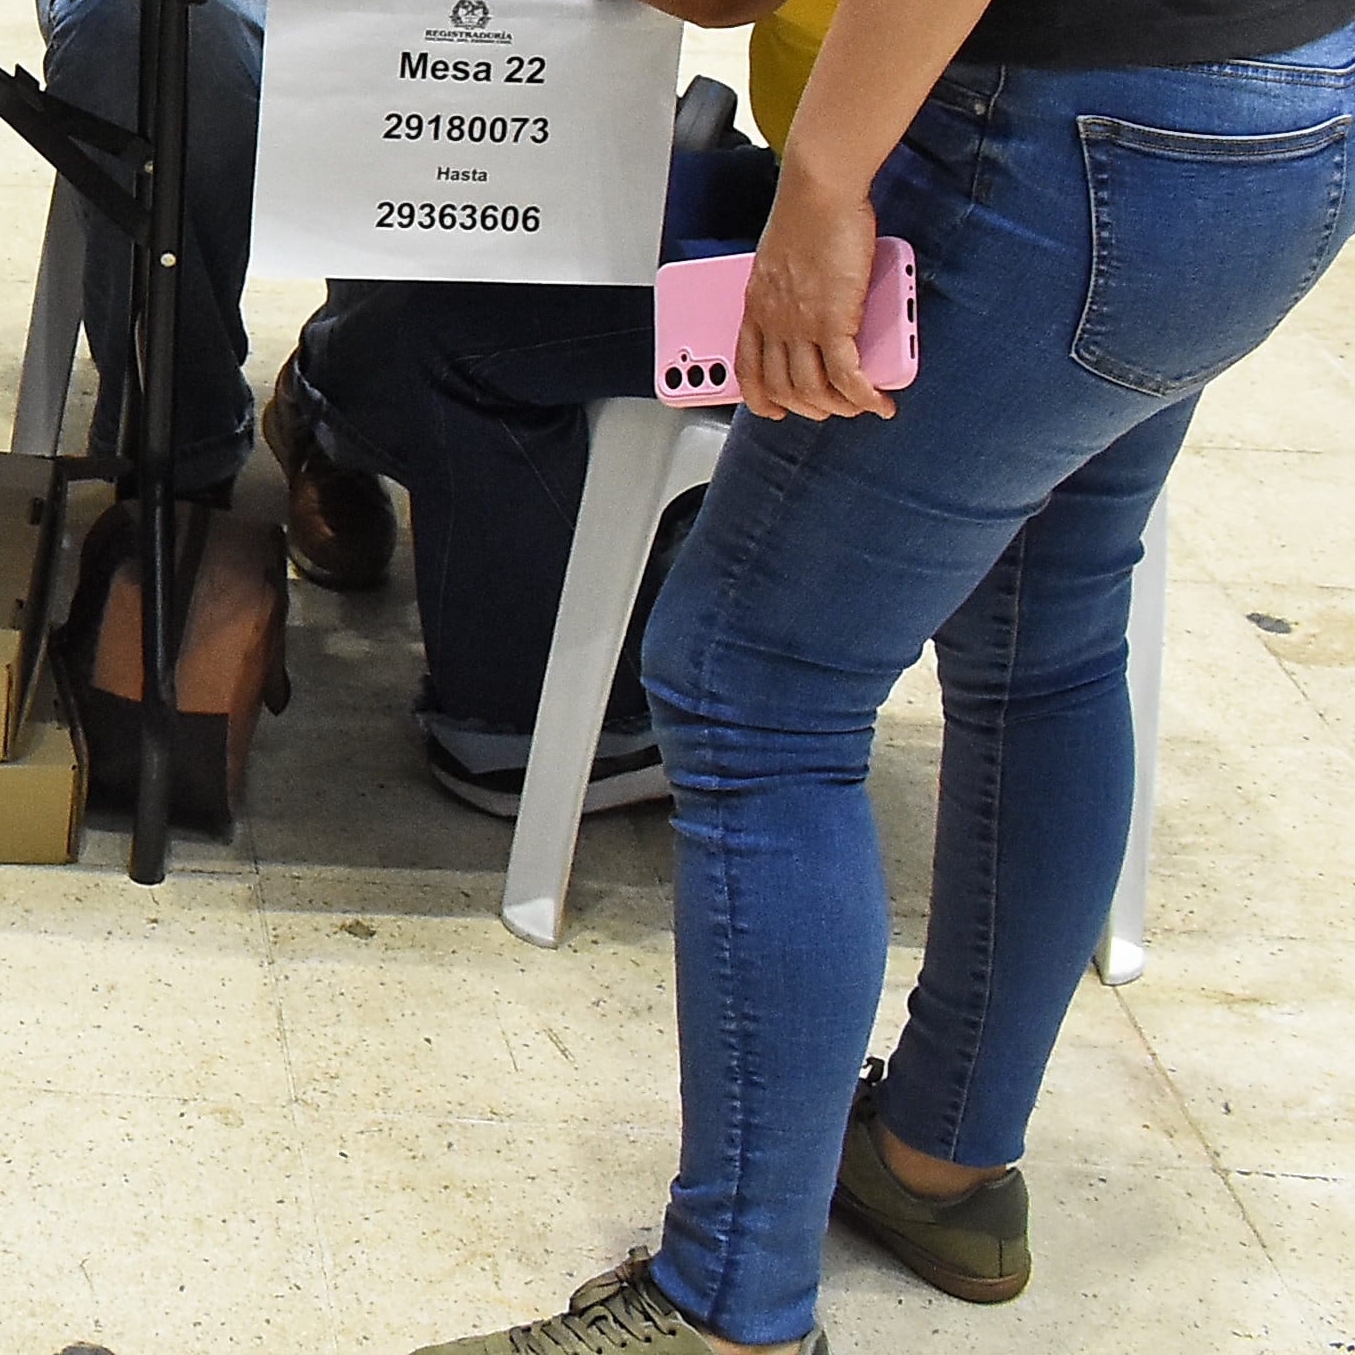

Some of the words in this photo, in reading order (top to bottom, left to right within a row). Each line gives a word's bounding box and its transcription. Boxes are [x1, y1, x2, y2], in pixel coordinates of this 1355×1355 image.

[425, 29, 512, 40] REGISTRADURÍA
[400, 52, 492, 82] Mesa
[504, 56, 546, 84] 22
[382, 113, 549, 144] 29180073
[437, 166, 488, 183] Hasta
[375, 201, 541, 232] 29363606
